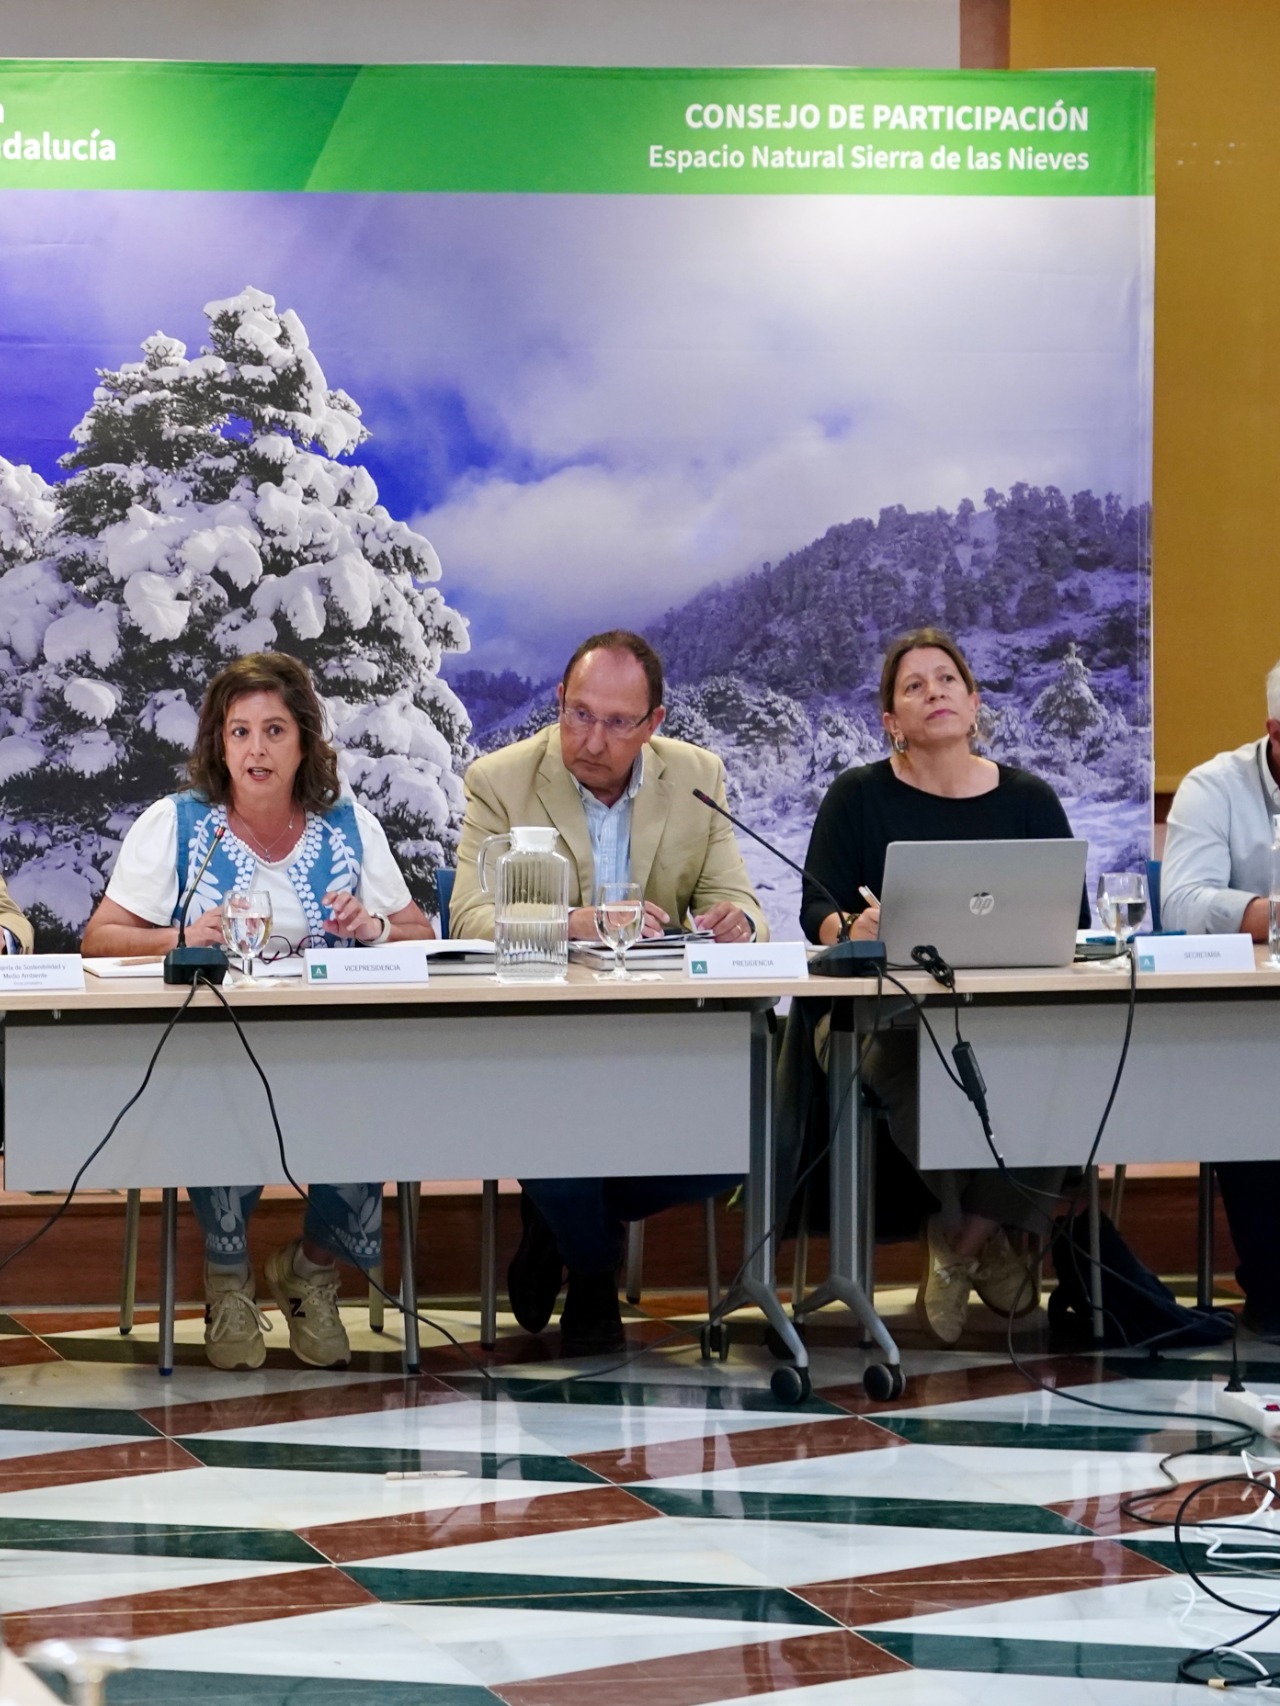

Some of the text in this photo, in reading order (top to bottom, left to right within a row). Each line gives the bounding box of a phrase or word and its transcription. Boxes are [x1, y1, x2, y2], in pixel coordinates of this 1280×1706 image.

[685, 100, 1089, 132] CONSEJO DE PARTICIPACIÓN
[649, 144, 1089, 174] Espacio Natural Sierra de las Nieves
[969, 891, 995, 916] hp
[344, 964, 401, 972] VICEPRESIDENCIA
